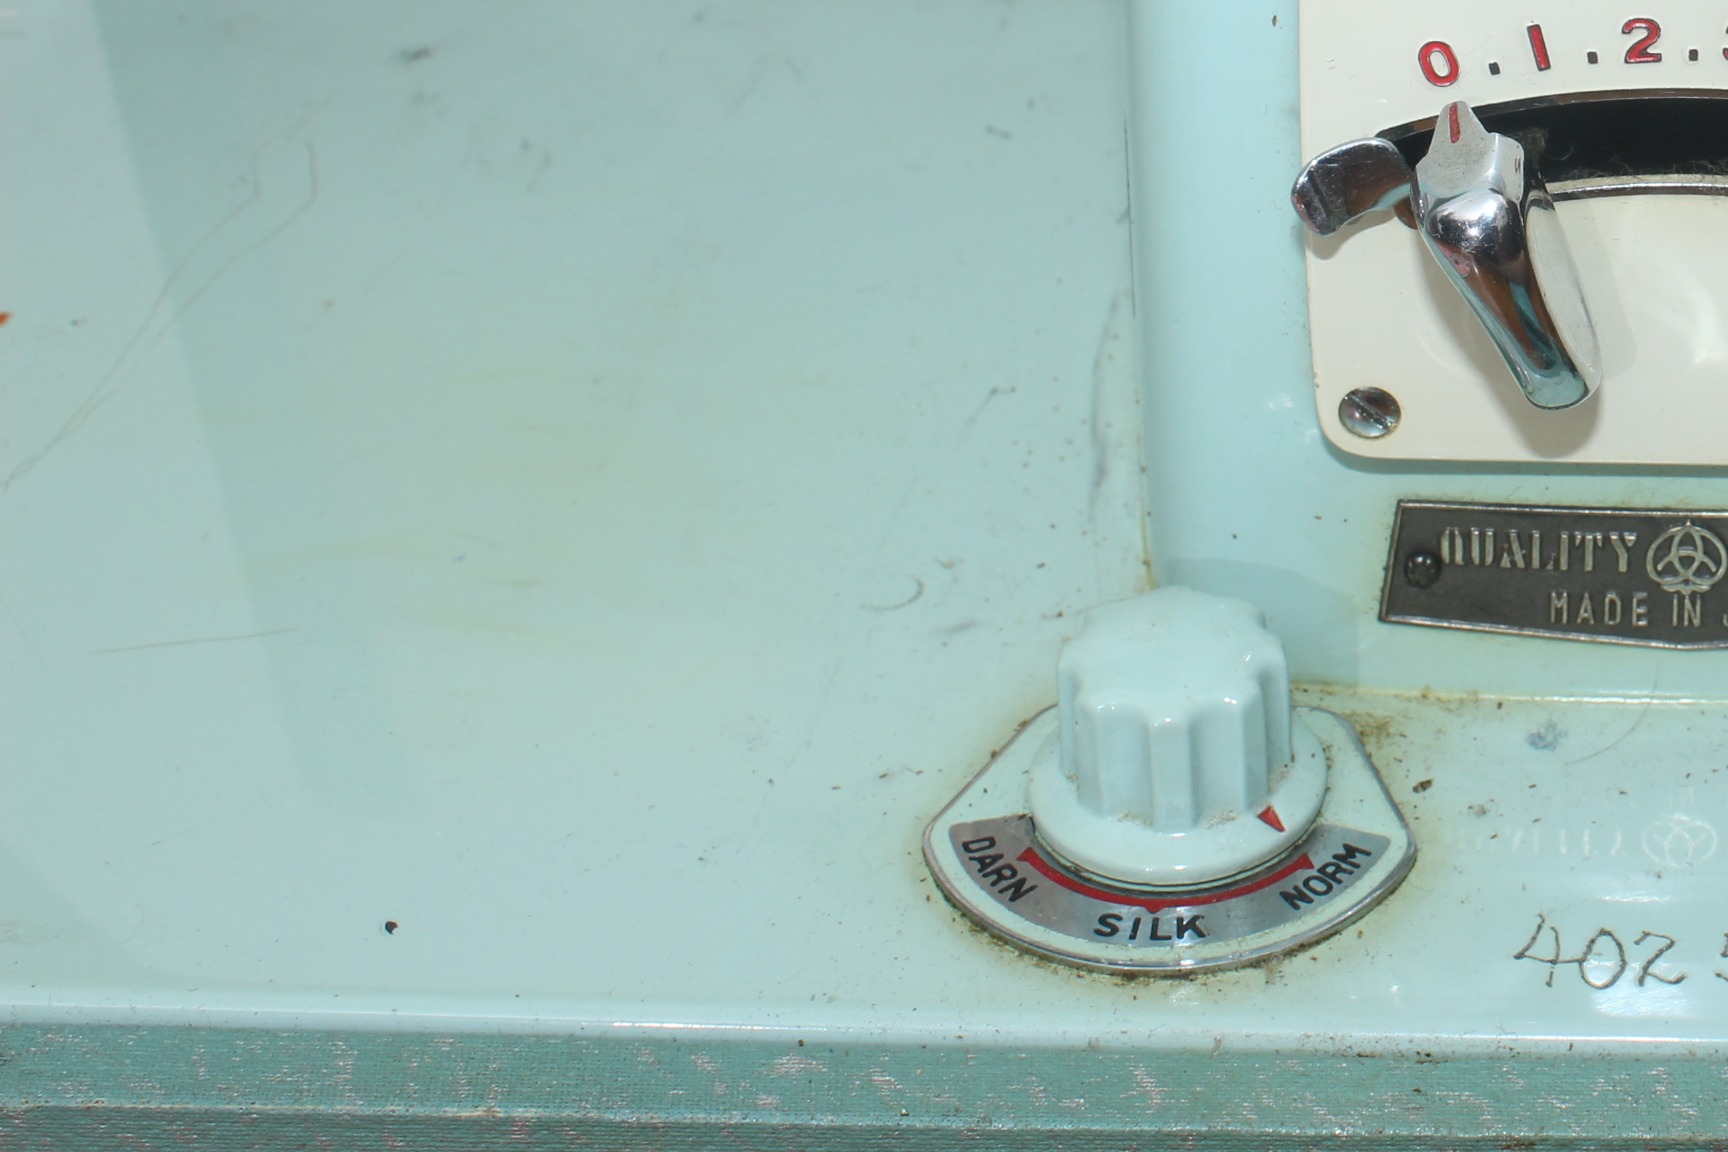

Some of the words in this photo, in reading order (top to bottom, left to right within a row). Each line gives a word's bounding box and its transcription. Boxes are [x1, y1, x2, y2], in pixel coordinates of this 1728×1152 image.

[1417, 39, 1461, 88] 0
[1526, 22, 1552, 72] 1
[1620, 17, 1663, 65] 2
[1439, 525, 1638, 574] QUALITY
[1549, 590, 1649, 627] MADE
[1672, 591, 1701, 629] IN
[962, 836, 1037, 903] DARN
[1092, 912, 1207, 942] SILK
[1280, 843, 1373, 911] NORM
[1513, 912, 1688, 989] 402
